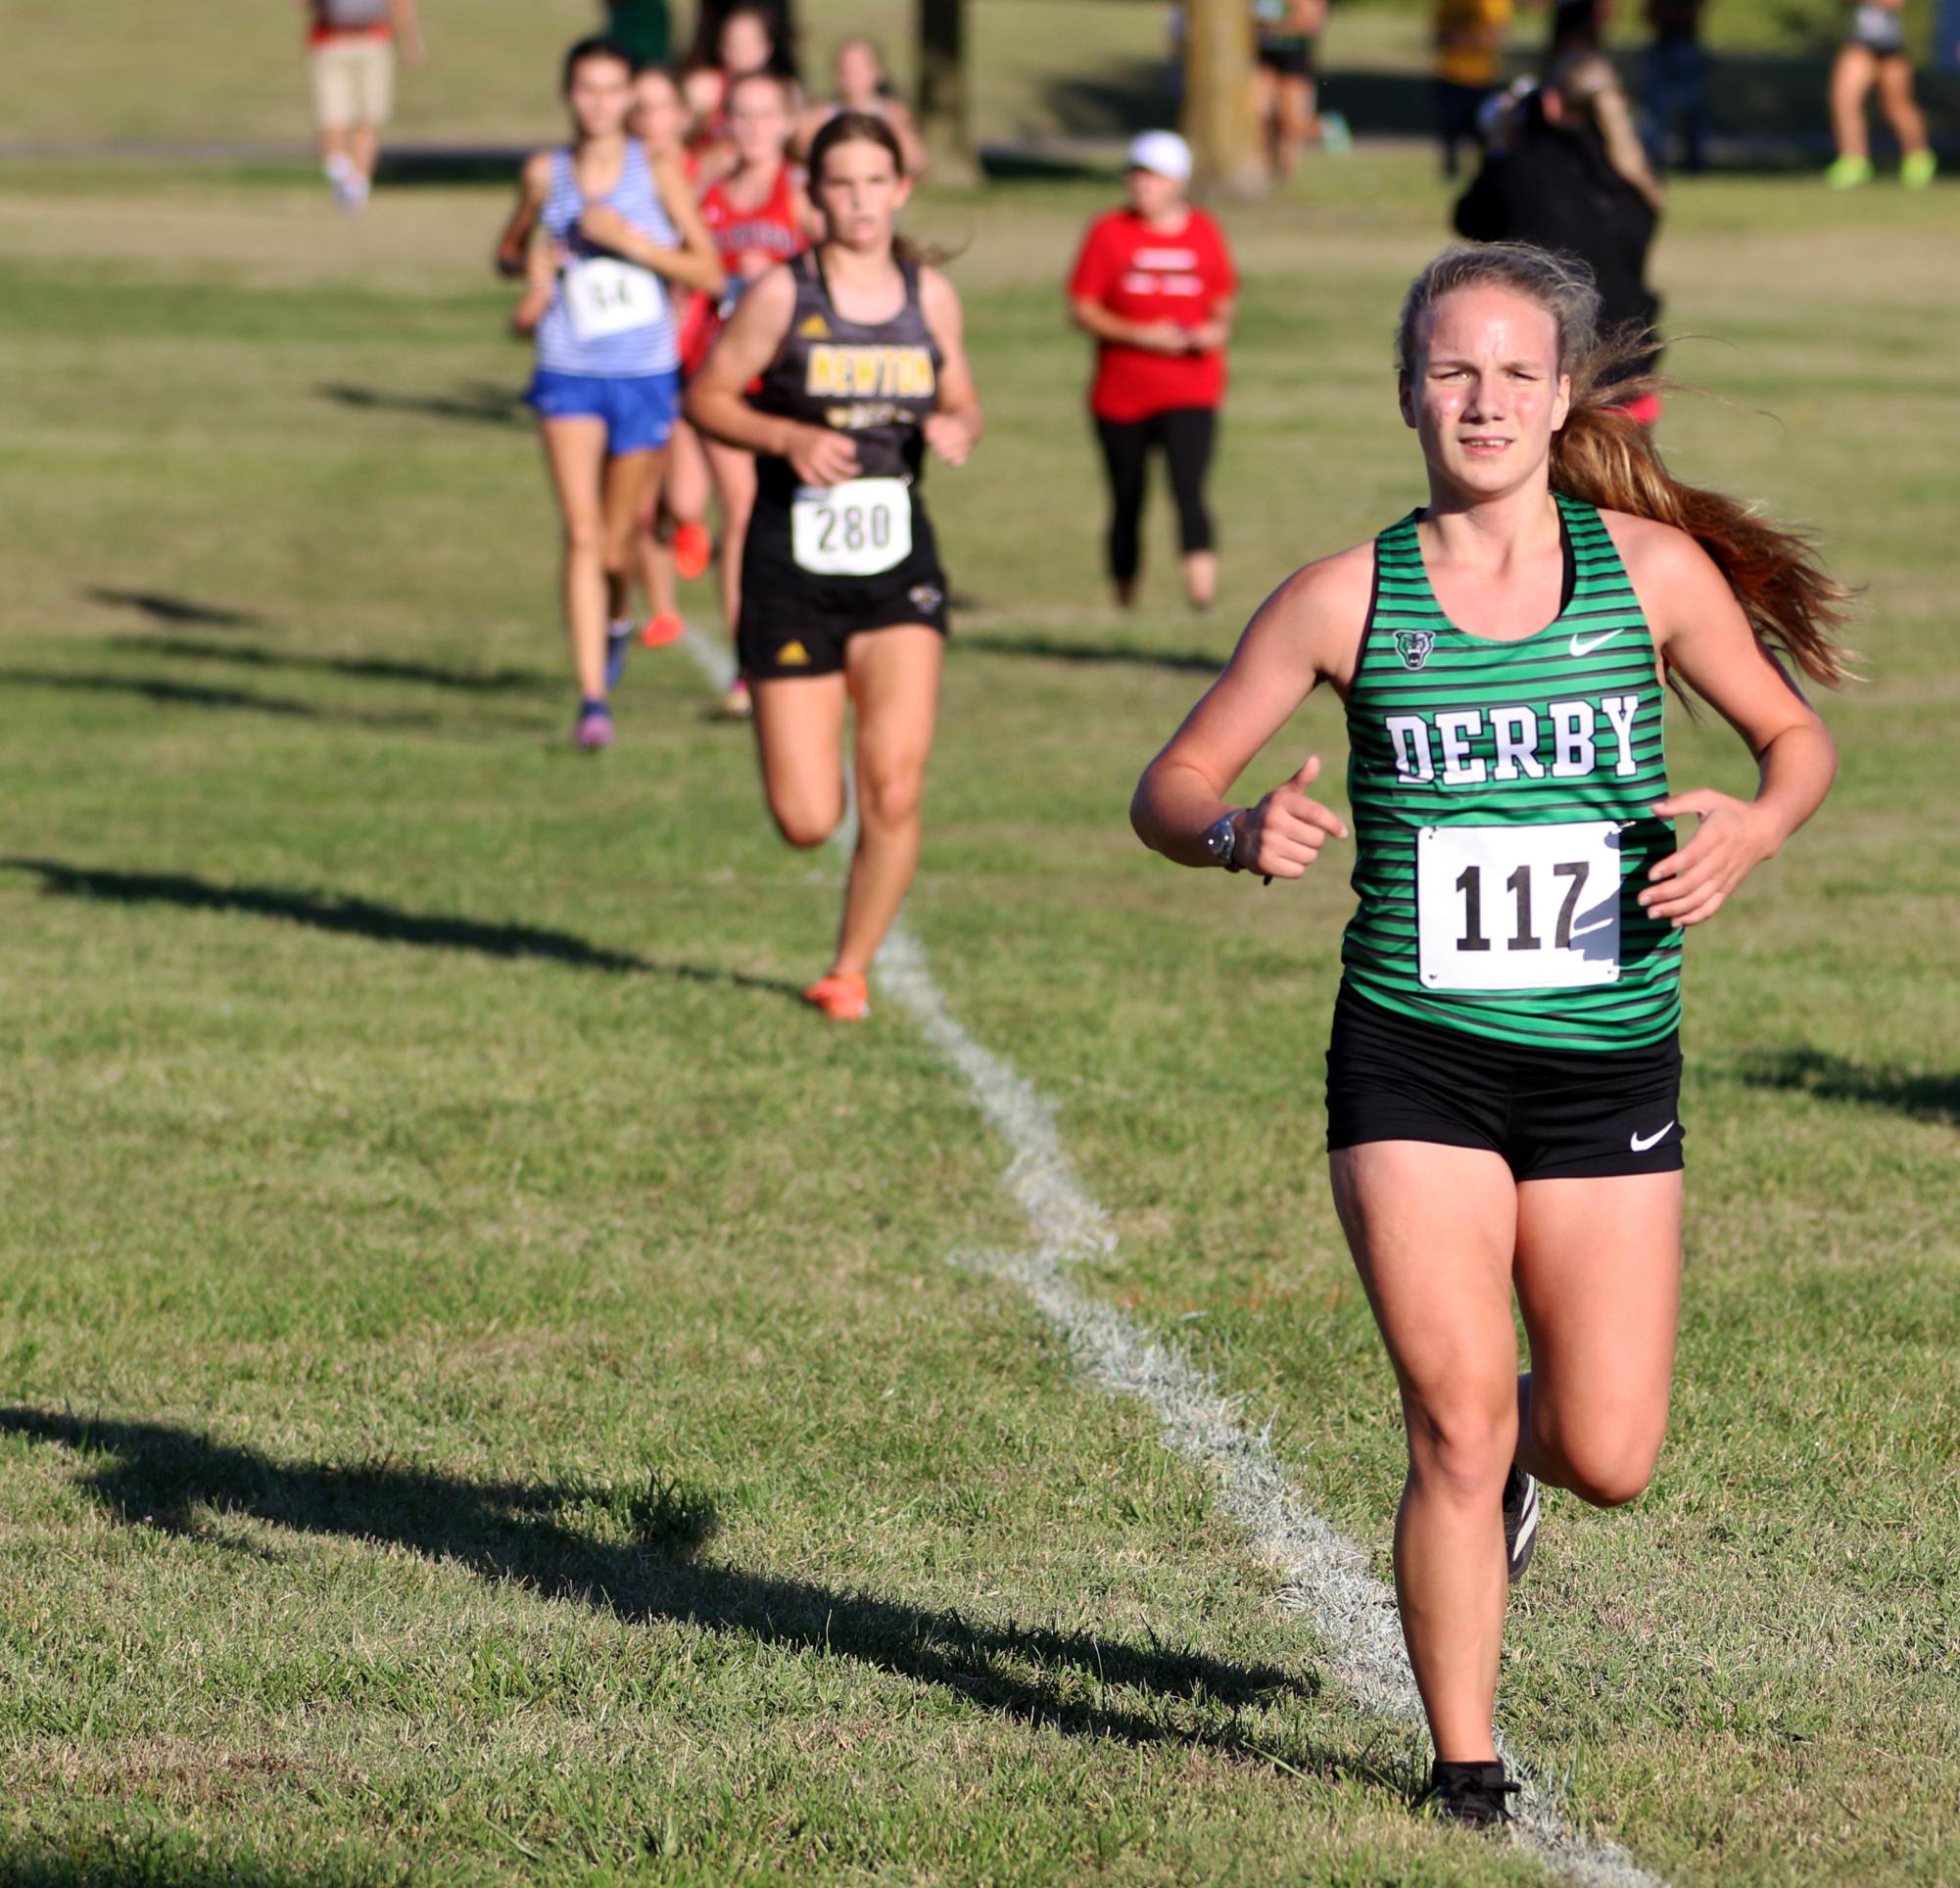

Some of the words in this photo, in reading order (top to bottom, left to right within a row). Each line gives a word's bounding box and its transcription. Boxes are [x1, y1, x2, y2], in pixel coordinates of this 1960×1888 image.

[805, 344, 934, 398] NEWTON
[815, 503, 890, 552] 280
[1385, 694, 1640, 786] DERBY
[1456, 861, 1591, 952] 117
